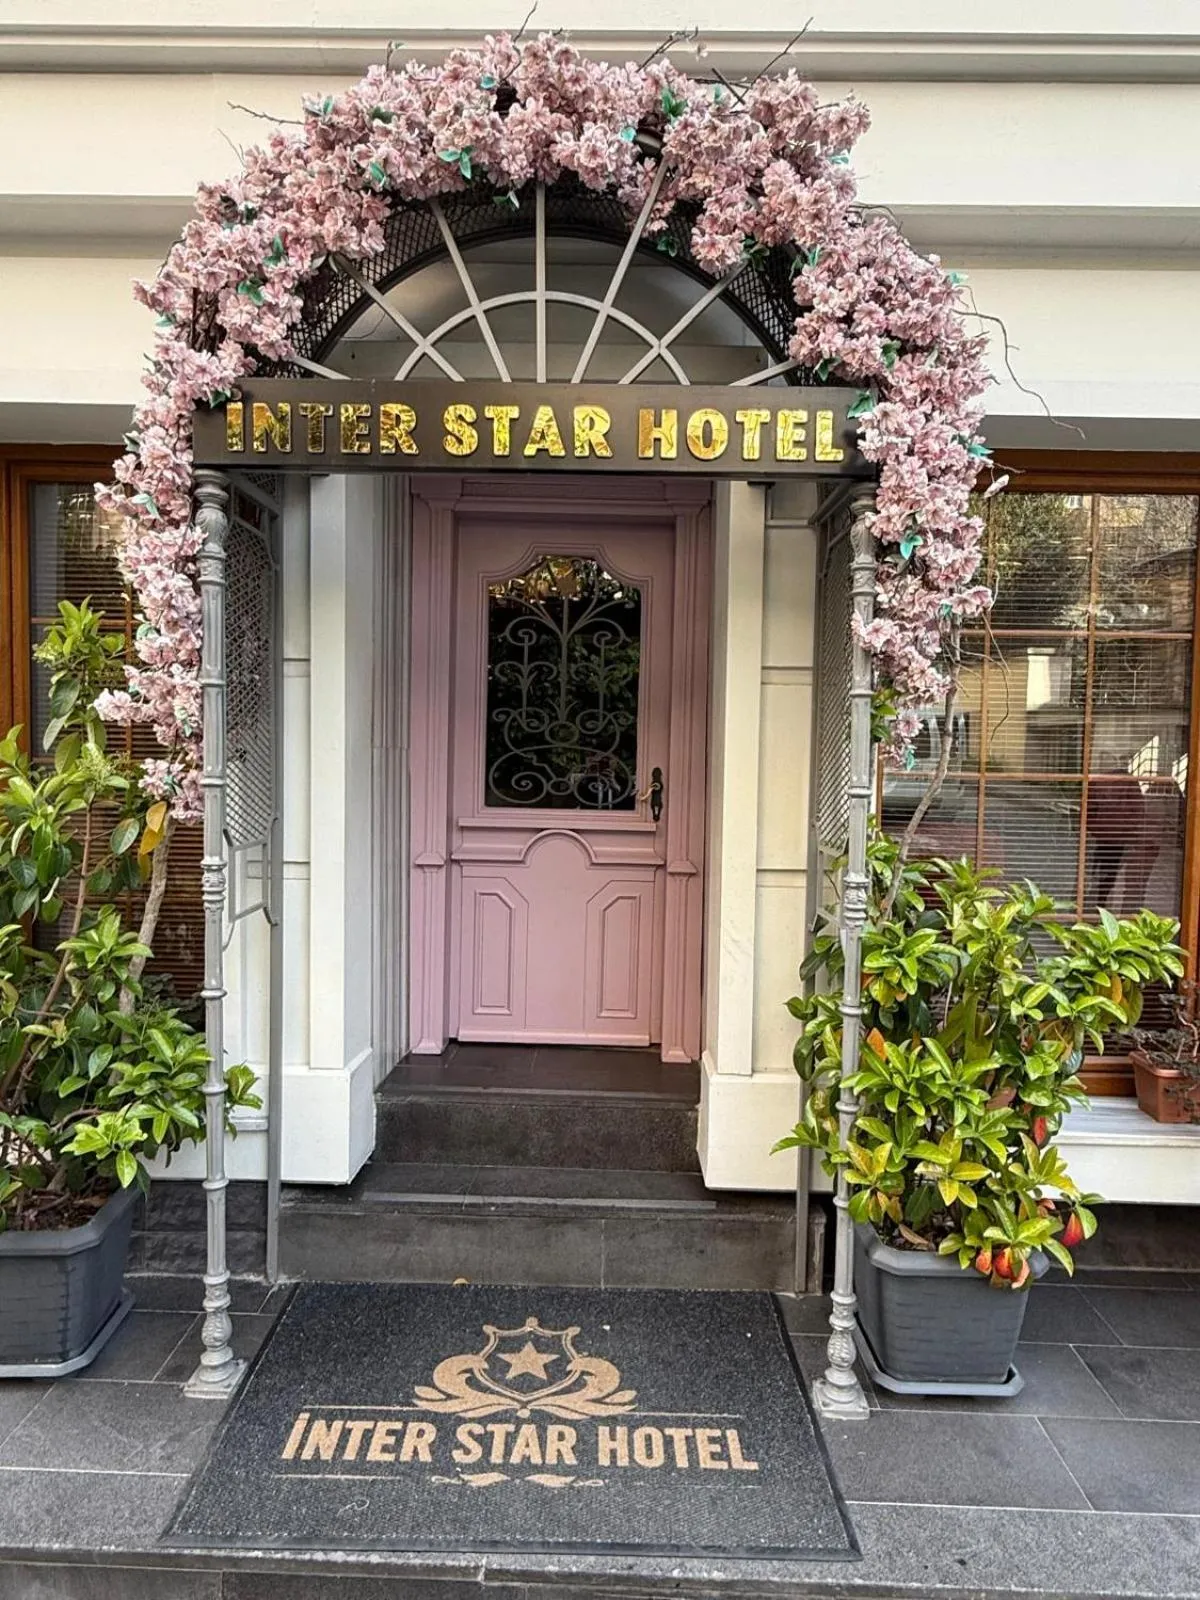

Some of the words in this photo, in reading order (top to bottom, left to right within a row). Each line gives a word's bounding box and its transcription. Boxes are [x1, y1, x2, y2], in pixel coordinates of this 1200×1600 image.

[225, 401, 418, 455] INTER
[442, 404, 613, 457] STAR
[638, 408, 845, 461] HOTEL
[451, 1423, 577, 1465] STAR
[599, 1427, 760, 1471] HOTEL
